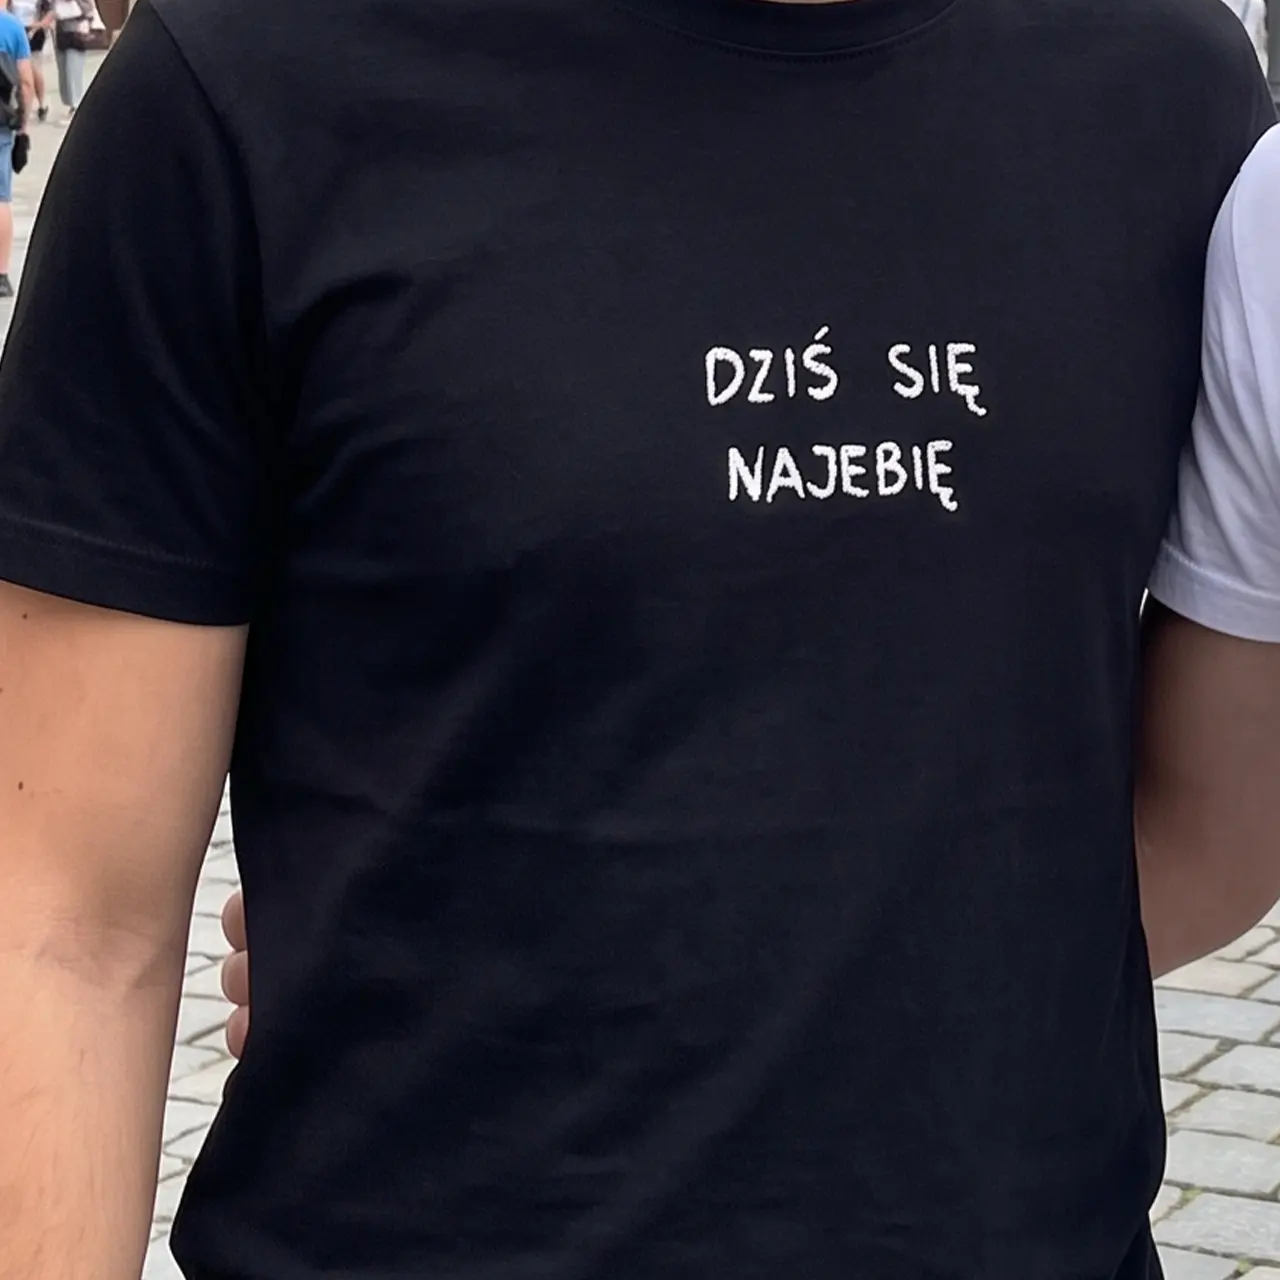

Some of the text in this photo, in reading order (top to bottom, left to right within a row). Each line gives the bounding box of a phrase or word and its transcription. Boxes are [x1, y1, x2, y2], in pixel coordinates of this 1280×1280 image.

[705, 326, 987, 417] DZIŚ SIĘ
[728, 439, 958, 512] NAJEBIĘ
